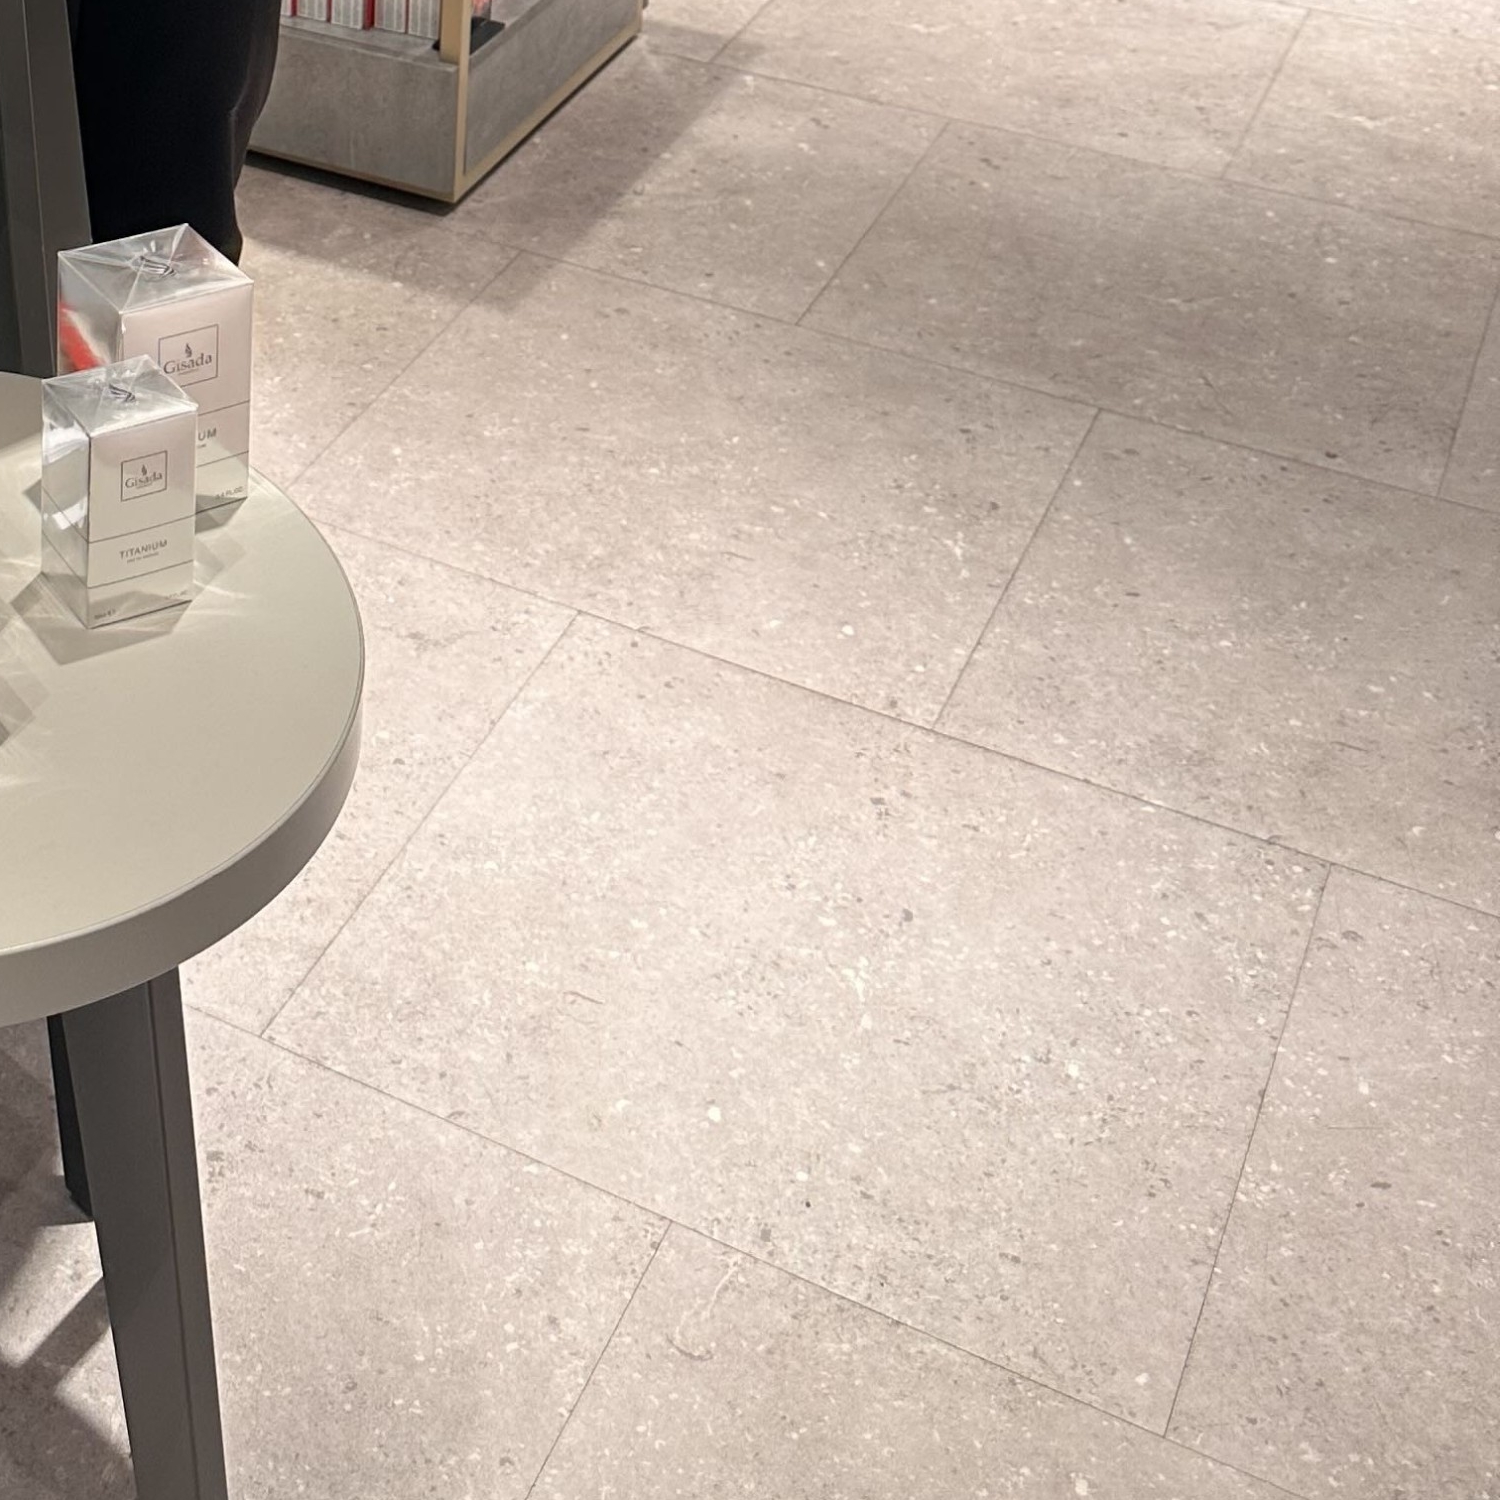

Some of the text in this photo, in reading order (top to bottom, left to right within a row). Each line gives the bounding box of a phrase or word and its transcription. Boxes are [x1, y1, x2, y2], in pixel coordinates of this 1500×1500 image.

[162, 351, 213, 376] Gisada
[124, 469, 163, 490] Gisada
[119, 538, 168, 560] TITANIUM
